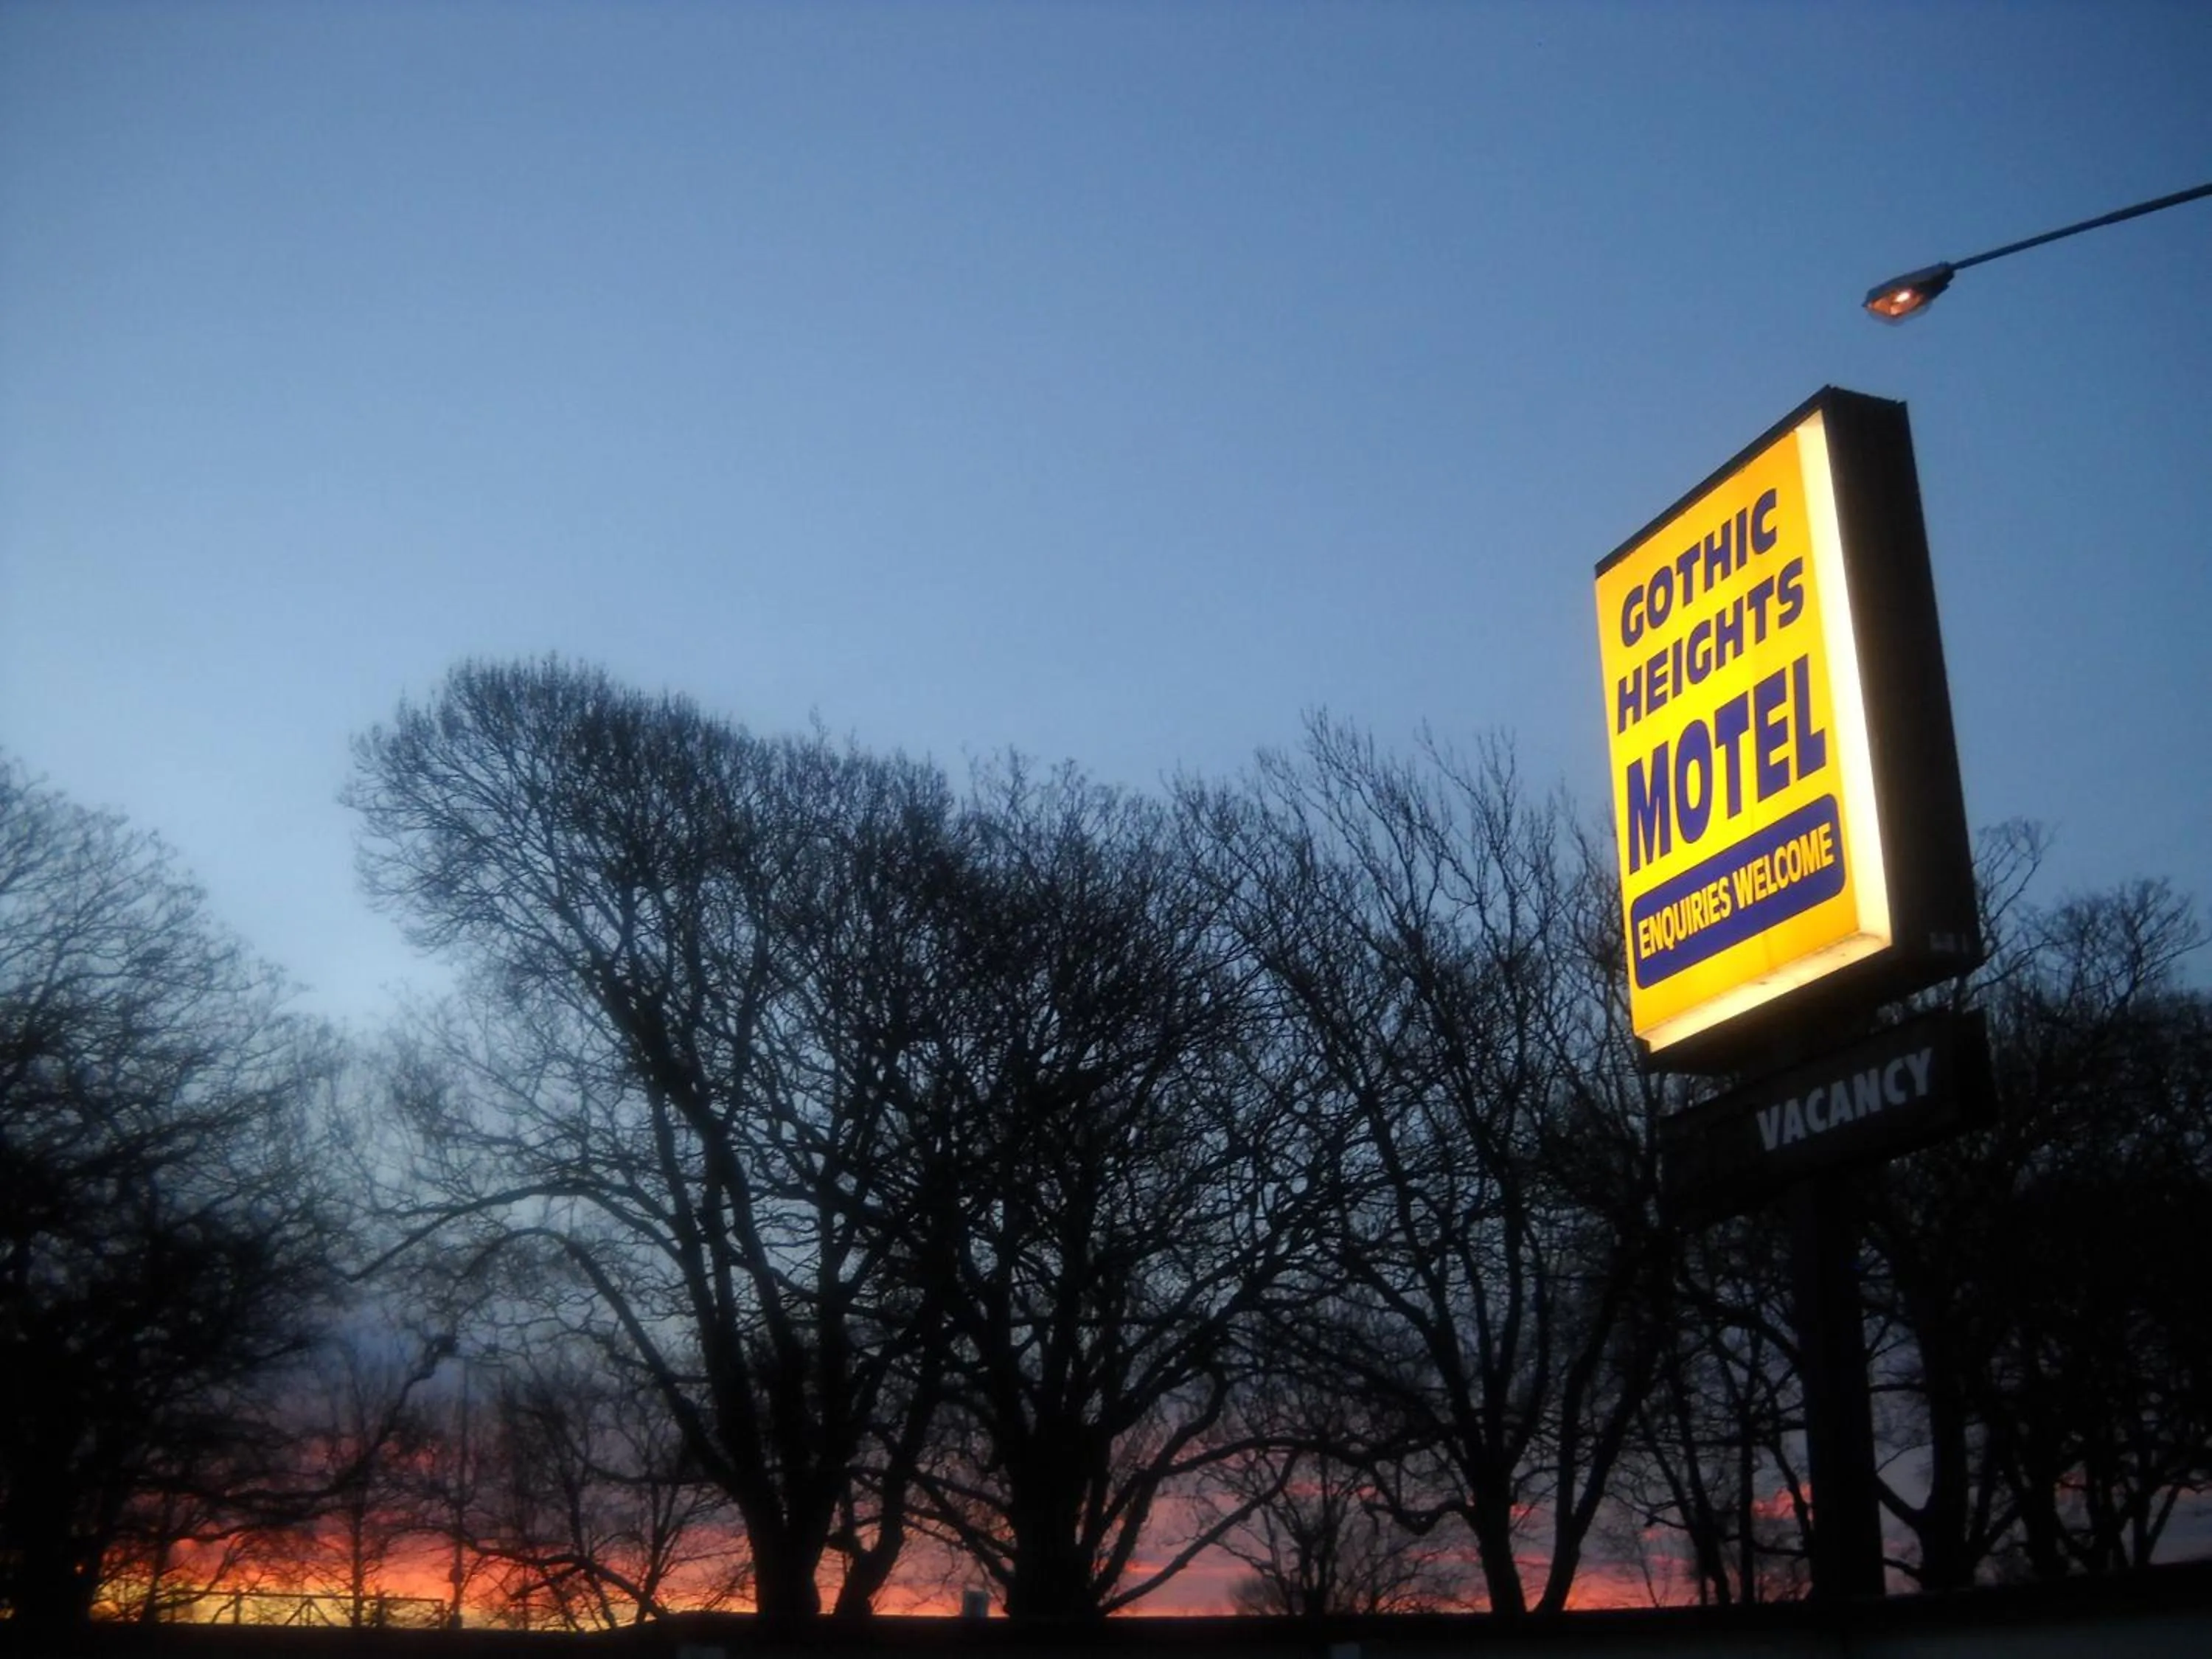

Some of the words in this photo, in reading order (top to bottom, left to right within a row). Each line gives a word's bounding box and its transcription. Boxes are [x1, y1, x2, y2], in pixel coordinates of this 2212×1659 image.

[1618, 557, 1804, 734] HEIGHTS
[1621, 489, 1777, 647] GOTHIC
[1627, 654, 1826, 875] MOTEL
[1638, 878, 1731, 959] ENQUIRIES
[1733, 822, 1834, 910] WELCOME
[1756, 1048, 1933, 1151] VACANCY
